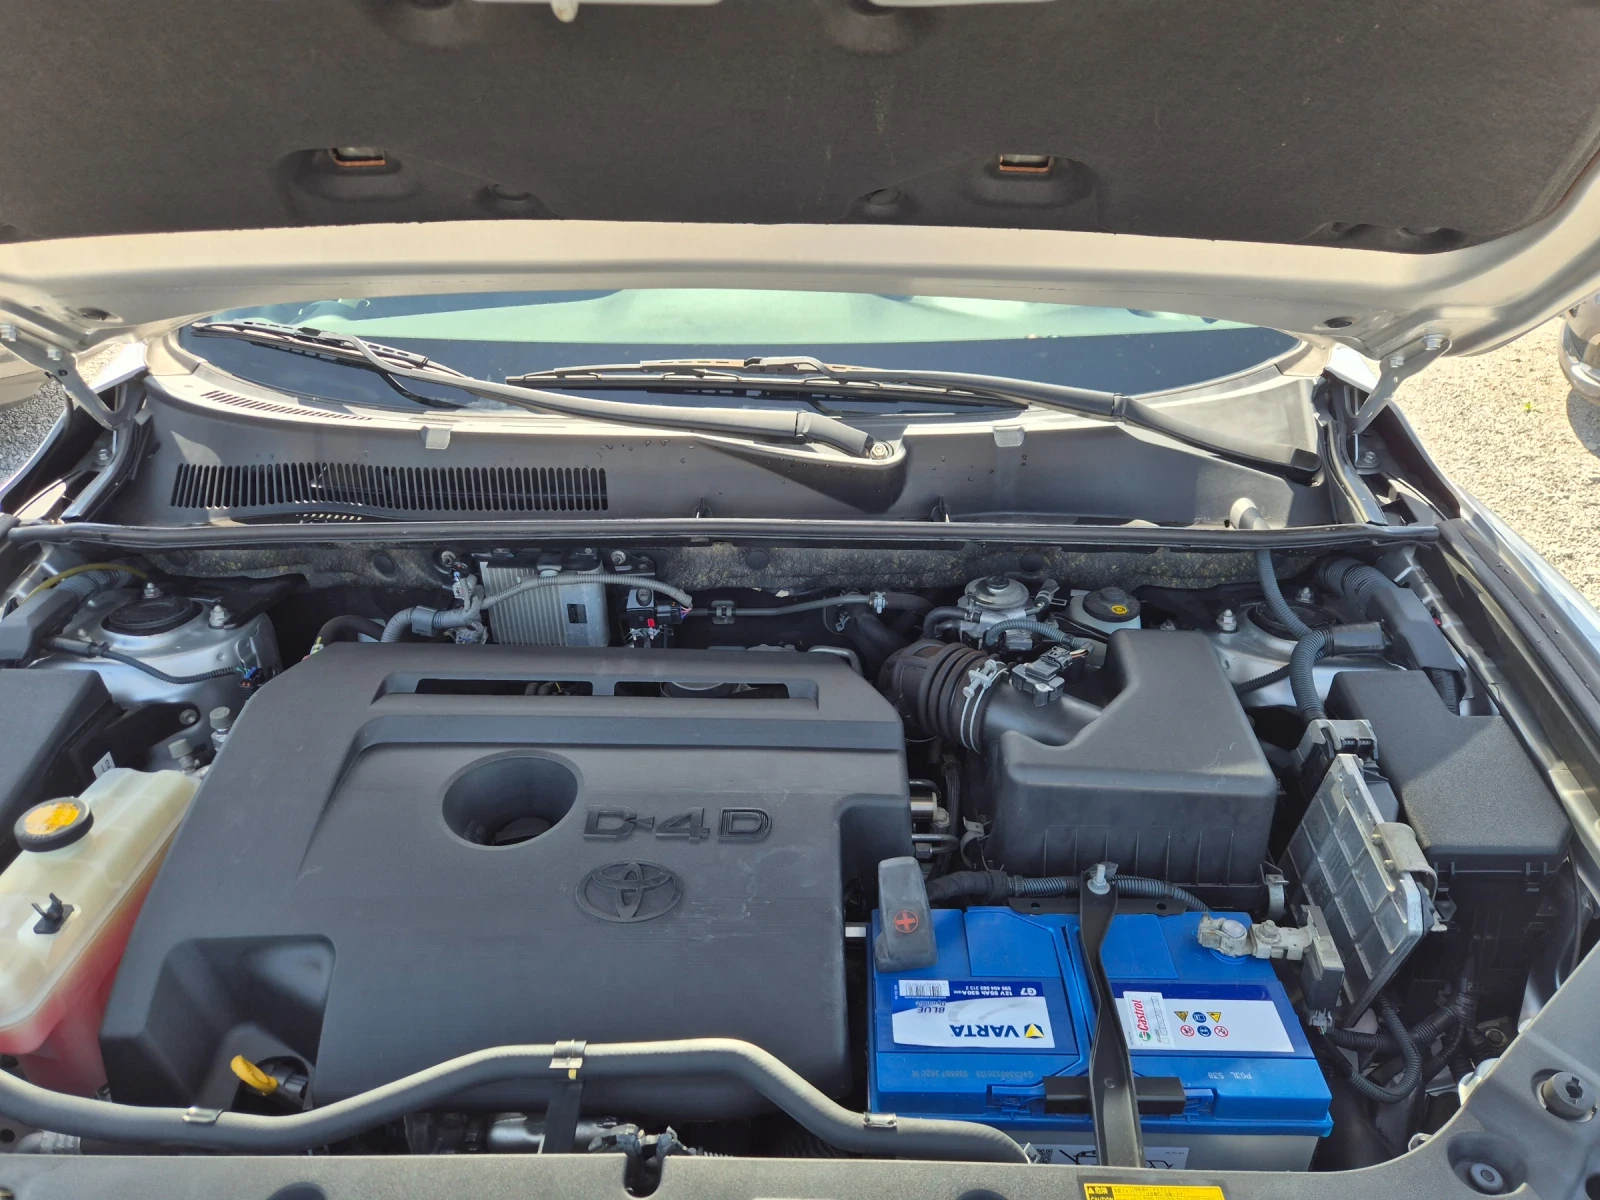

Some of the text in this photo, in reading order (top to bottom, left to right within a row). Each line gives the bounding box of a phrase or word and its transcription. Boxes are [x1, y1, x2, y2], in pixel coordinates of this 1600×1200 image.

[1020, 987, 1037, 996] G7
[917, 1006, 945, 1014] BLUE
[1131, 999, 1149, 1031] Castrol
[949, 1025, 1020, 1038] VARTA
